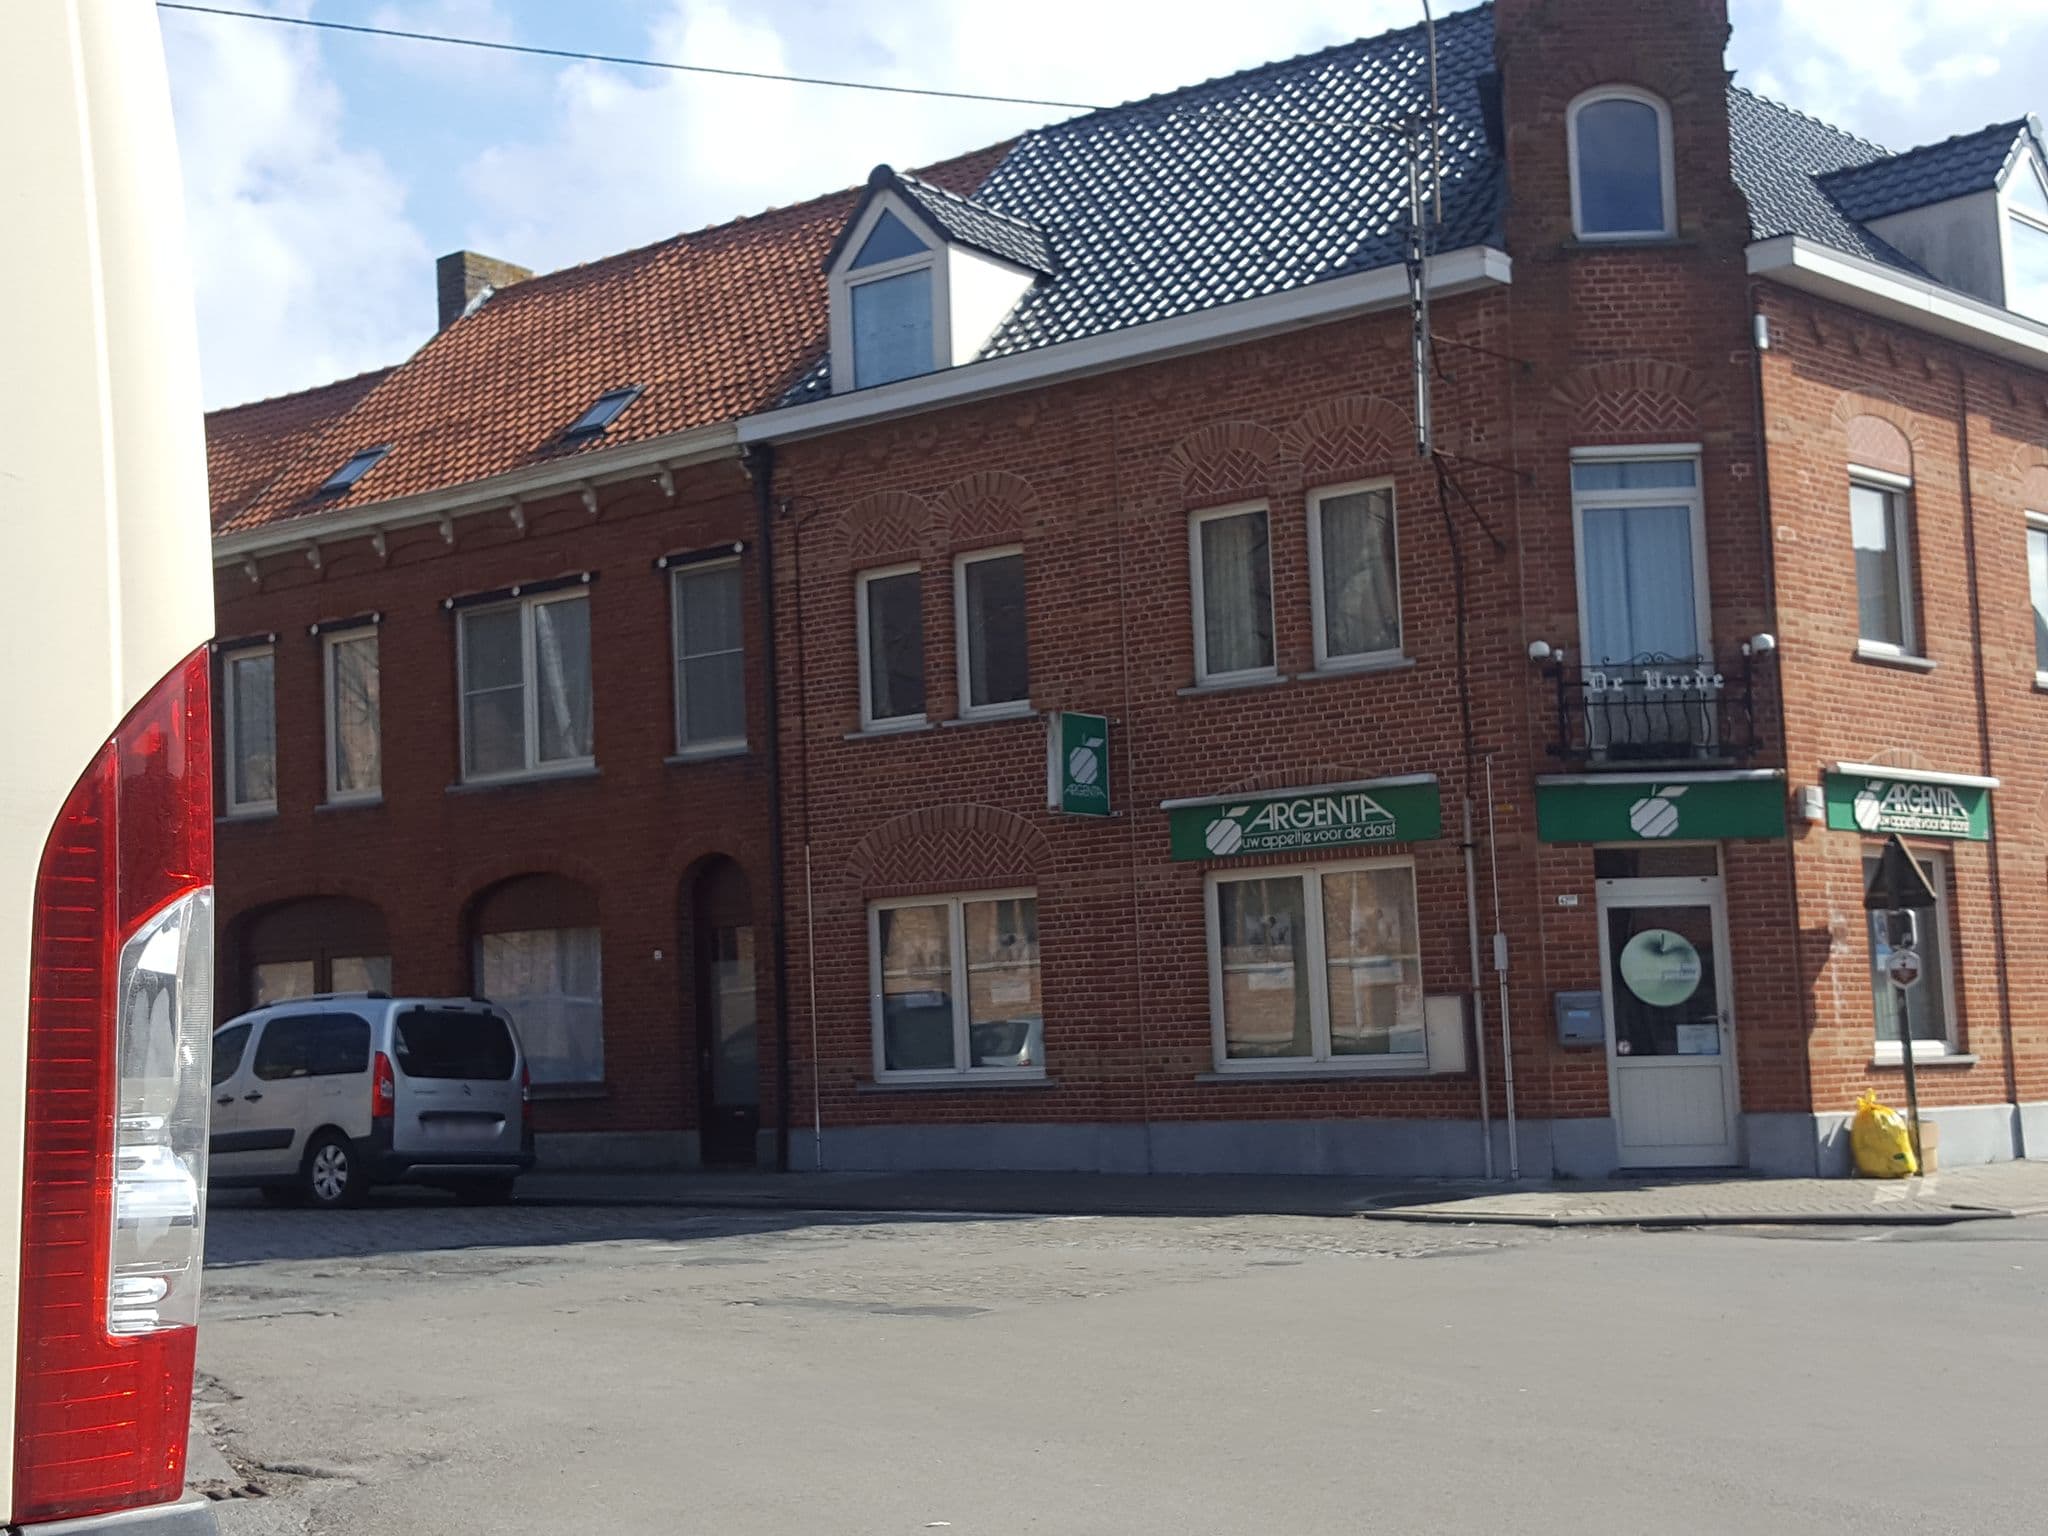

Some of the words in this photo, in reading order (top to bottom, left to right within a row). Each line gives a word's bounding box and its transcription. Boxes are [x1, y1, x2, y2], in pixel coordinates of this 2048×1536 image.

[1244, 793, 1395, 833] ARGENTA
[1879, 783, 1969, 817] ARGENTA
[1243, 838, 1259, 849] uw
[1261, 829, 1312, 849] appeltje
[1314, 829, 1342, 842] voor
[1345, 825, 1362, 839] de
[1363, 822, 1395, 838] dorst
